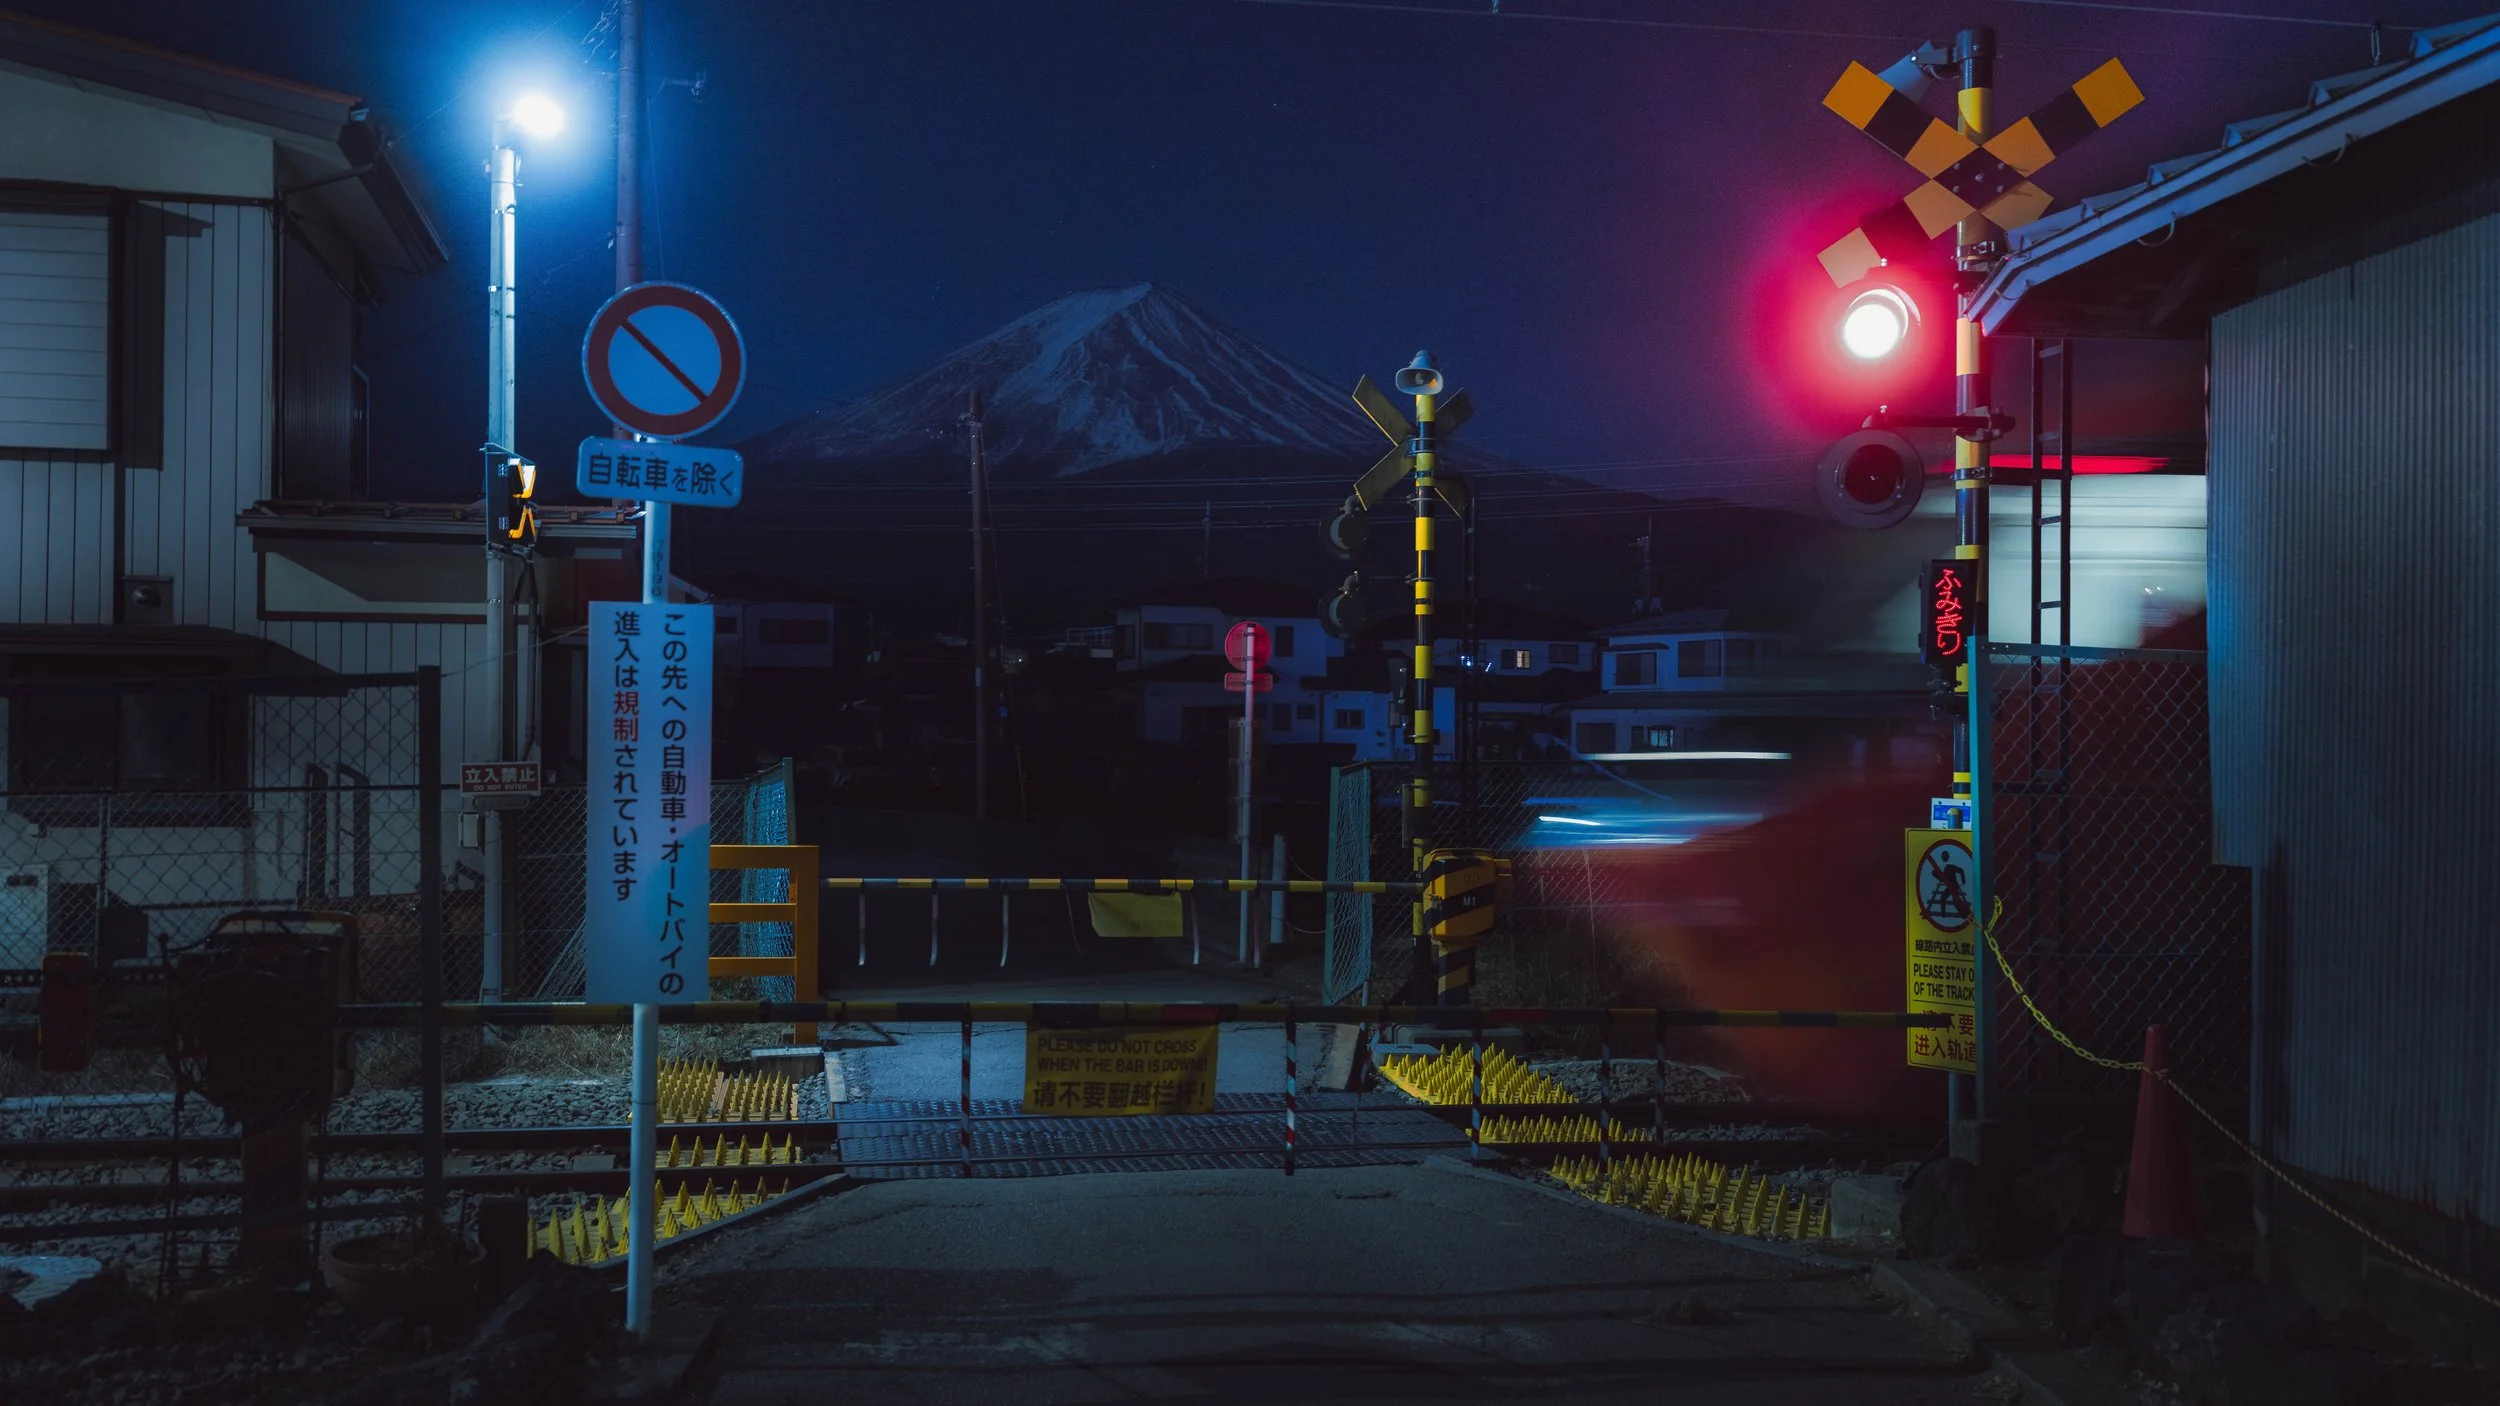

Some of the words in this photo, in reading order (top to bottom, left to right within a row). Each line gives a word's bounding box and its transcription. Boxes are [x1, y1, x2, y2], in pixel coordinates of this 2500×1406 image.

[589, 452, 734, 496] 自転車を除く
[1935, 568, 1963, 656] ふみきり
[612, 611, 641, 901] 進入は規制されています
[465, 767, 535, 783] 立入禁止
[659, 613, 687, 996] この先への自動車・オートバイの
[1913, 963, 1944, 980] PLEASE
[1945, 967, 1966, 982] STAY
[1914, 982, 1925, 996] OF
[1927, 983, 1944, 998] THE
[1037, 1036, 1093, 1053] PLEASE
[1098, 1039, 1119, 1054] DO
[1122, 1039, 1151, 1054] NOT
[1154, 1039, 1198, 1054] CROSS
[1037, 1057, 1080, 1072] WHEN
[1084, 1057, 1113, 1072] THE
[1116, 1058, 1144, 1073] BAR
[1148, 1059, 1161, 1073] IS
